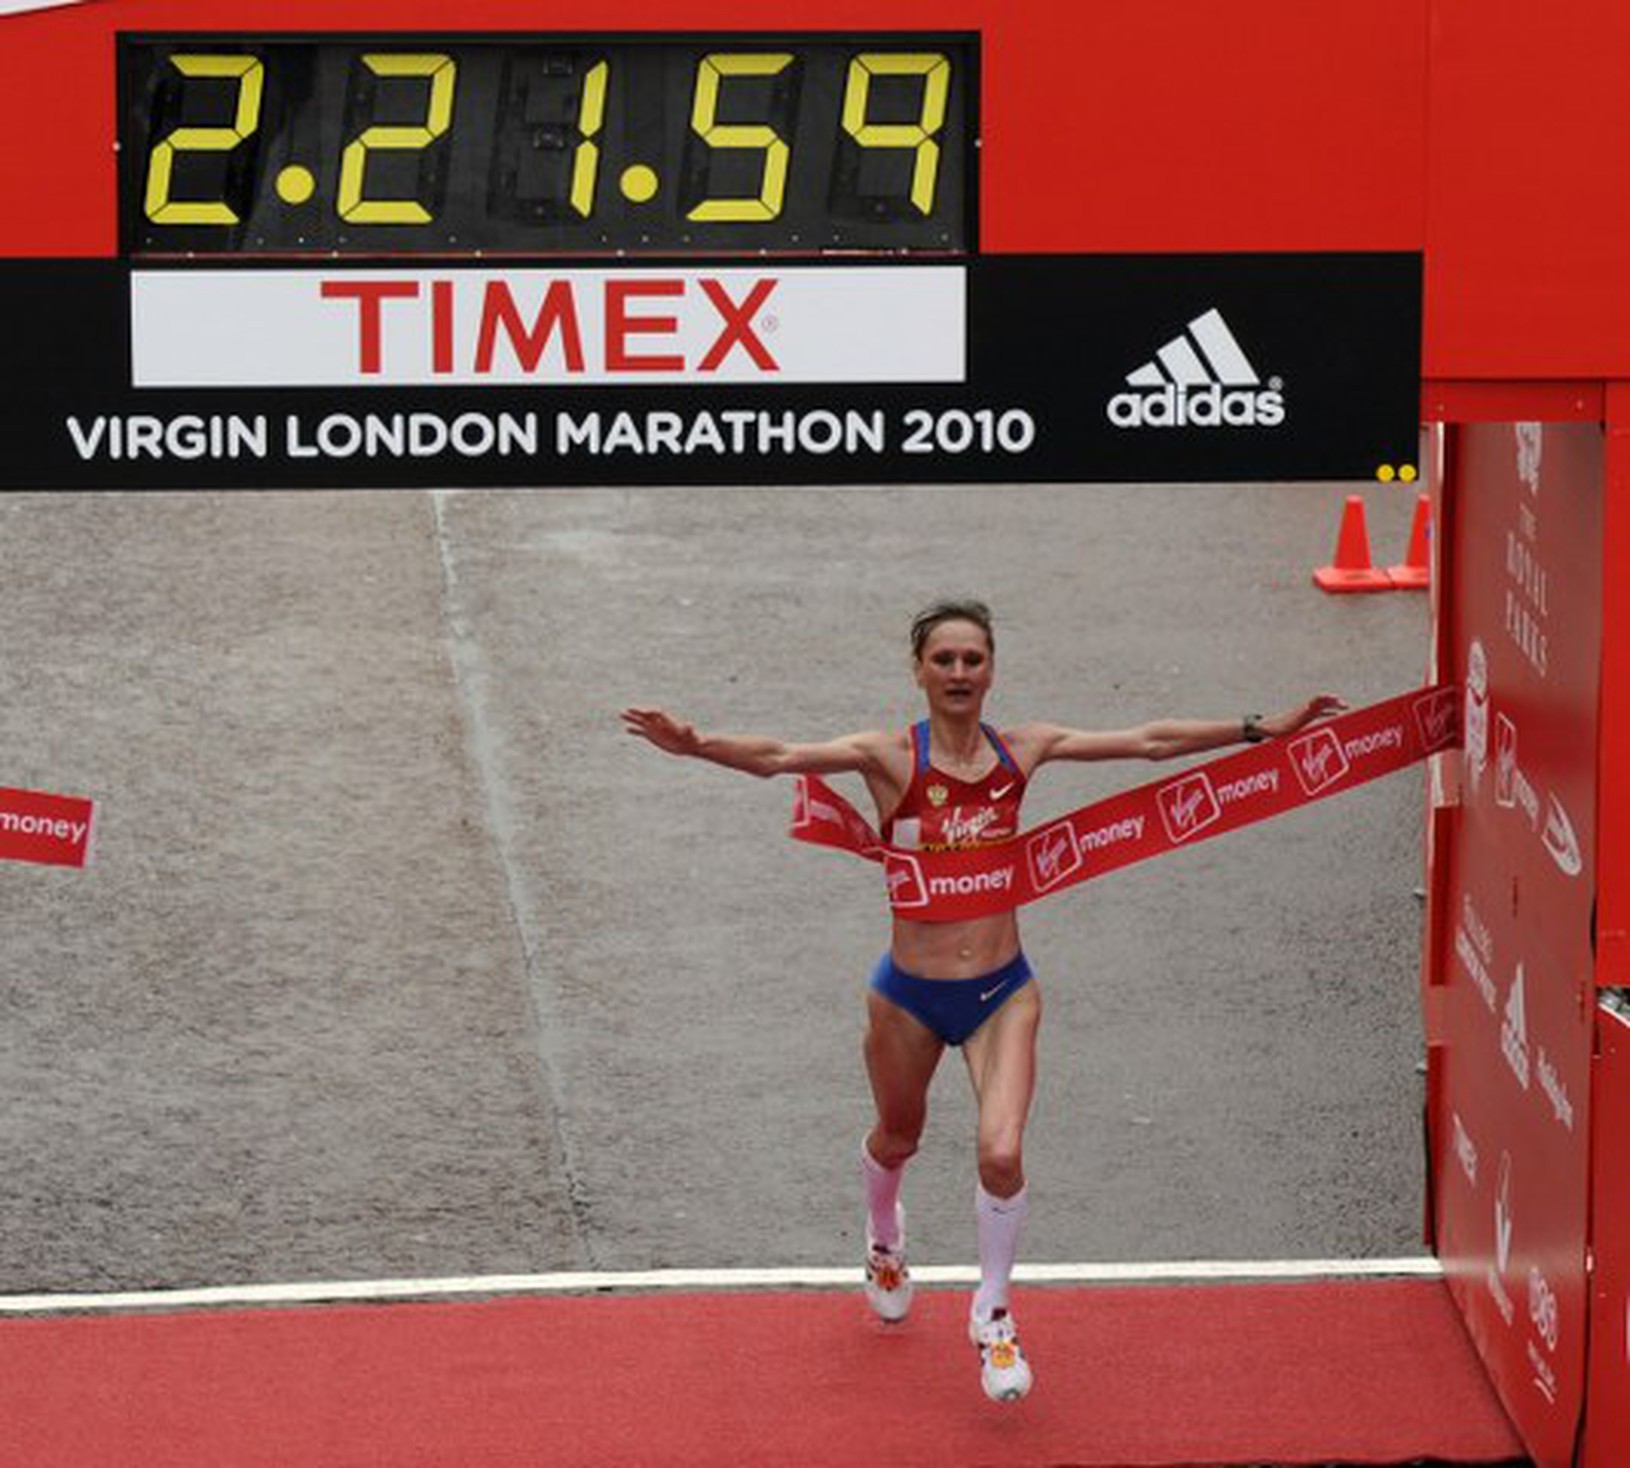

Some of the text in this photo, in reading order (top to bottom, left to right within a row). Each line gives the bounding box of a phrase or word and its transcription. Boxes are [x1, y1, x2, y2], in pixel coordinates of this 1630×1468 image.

[320, 278, 780, 374] TIMEX
[1106, 382, 1286, 428] adidas
[66, 408, 1036, 459] VIRGIN LONDON MARATHON 2010
[0, 812, 87, 845] money
[929, 864, 1014, 895] money
[1079, 815, 1145, 854] money
[1217, 767, 1279, 804] money
[1345, 725, 1404, 760] money
